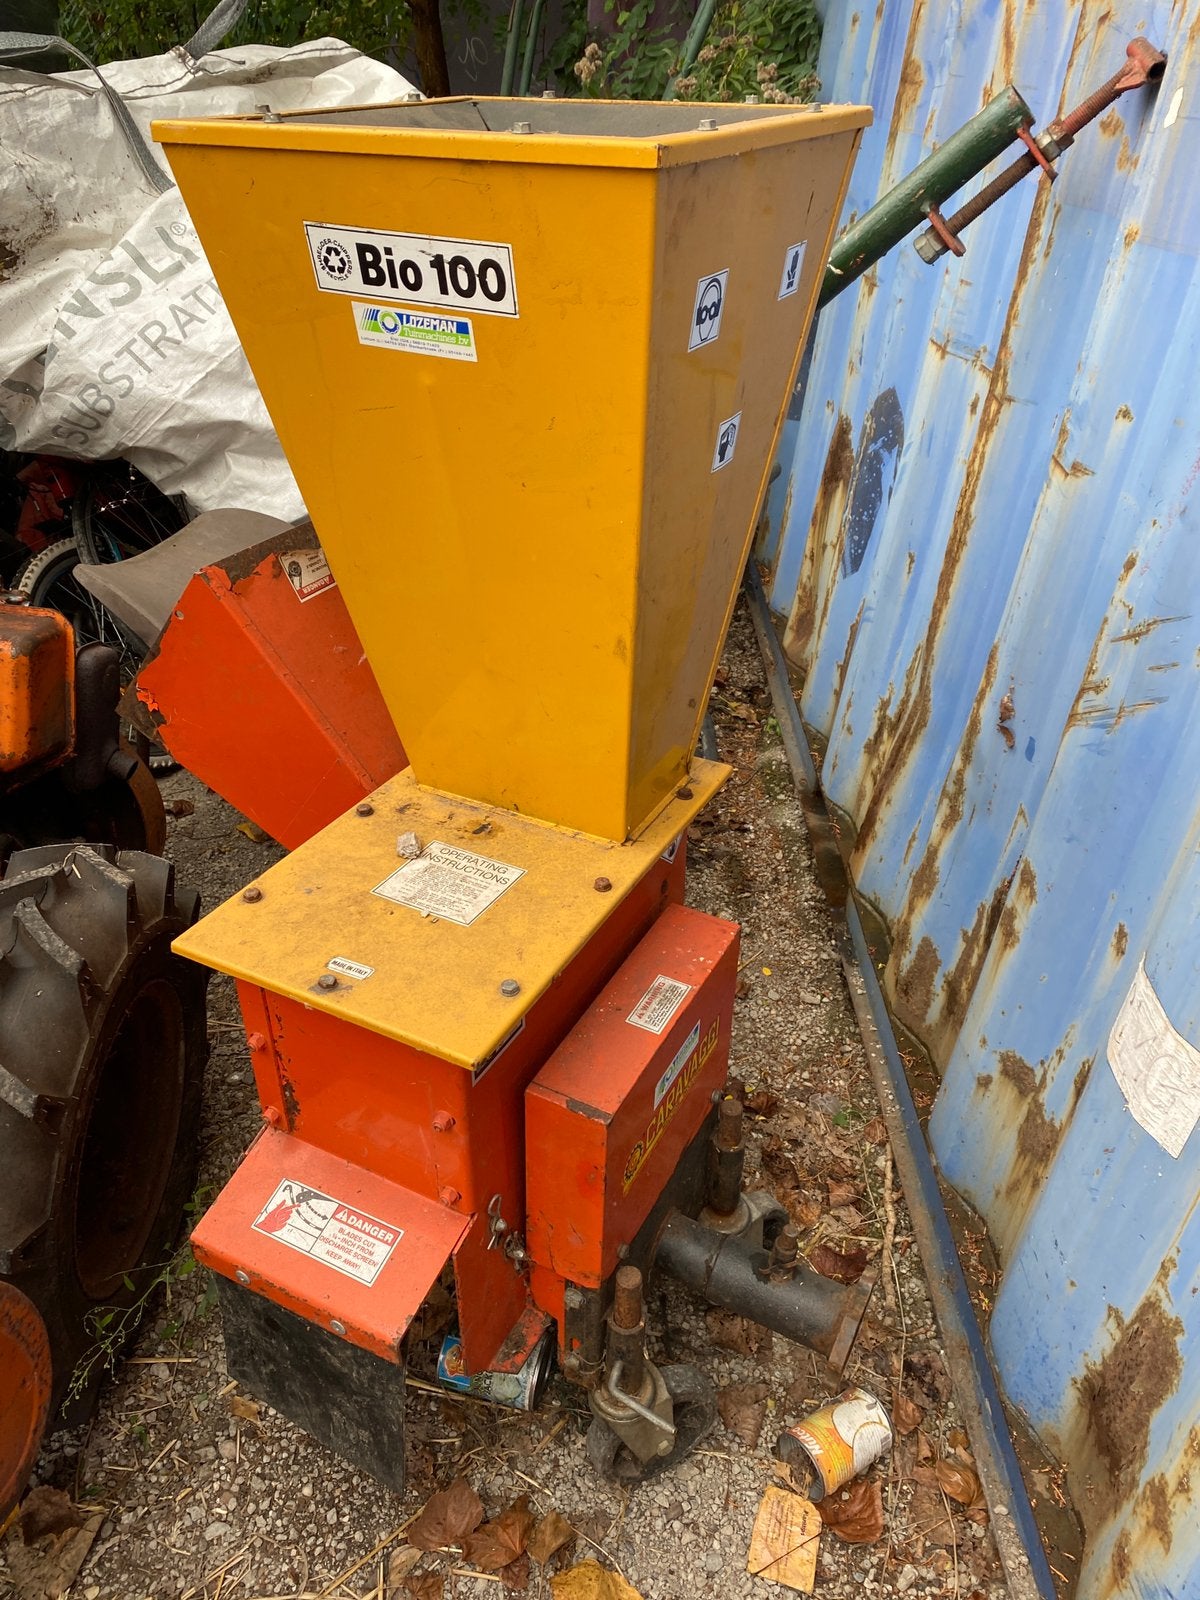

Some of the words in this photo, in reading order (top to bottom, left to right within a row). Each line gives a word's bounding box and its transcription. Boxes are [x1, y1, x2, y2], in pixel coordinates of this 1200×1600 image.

[355, 242, 423, 292] Bio
[429, 253, 507, 303] 100
[403, 314, 457, 334] LOZEMAN
[403, 327, 456, 344] Tuinmachines
[458, 335, 469, 345] bv
[303, 579, 323, 593] DANGER
[421, 852, 510, 885] INSTRUCTIONS
[440, 847, 509, 875] OPERATING
[352, 967, 368, 976] ITALY
[640, 981, 666, 1011] WARNING
[646, 1015, 720, 1149] CARAVAGGI
[338, 1227, 363, 1242] BLADES
[362, 1239, 376, 1249] CUT
[347, 1215, 394, 1243] DANGER
[319, 1234, 353, 1256] DISCHARGE
[352, 1251, 379, 1268] SCREEN!
[325, 1249, 342, 1261] KEEP
[342, 1258, 361, 1270] AWAY!
[356, 1244, 375, 1257] FROM
